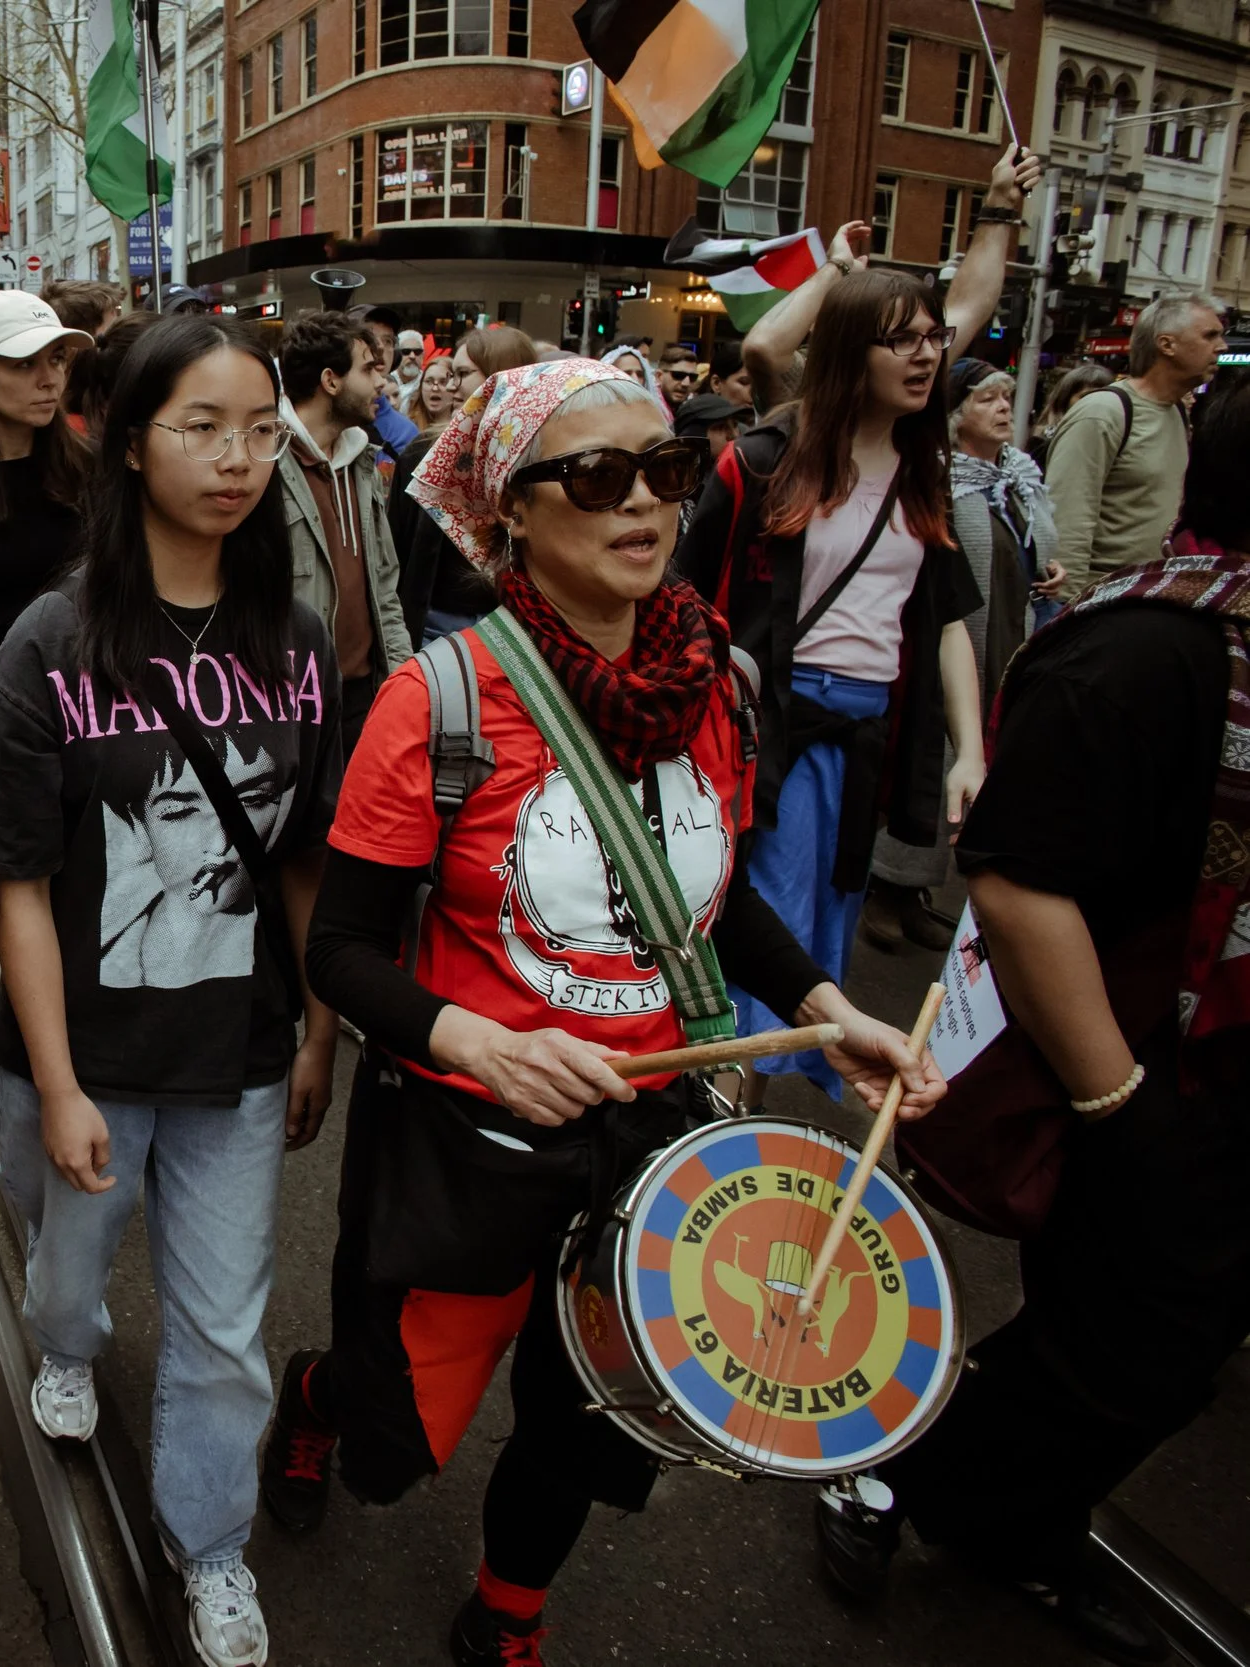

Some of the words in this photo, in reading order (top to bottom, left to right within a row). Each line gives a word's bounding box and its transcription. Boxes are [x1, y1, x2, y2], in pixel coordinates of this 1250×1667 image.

[385, 136, 412, 150] OPE
[559, 984, 629, 1010] STICK
[947, 1011, 960, 1039] sight
[958, 988, 977, 1040] captives
[775, 1172, 815, 1198] DE
[682, 1174, 759, 1245] SAMBA
[721, 1354, 872, 1414] BATERIA
